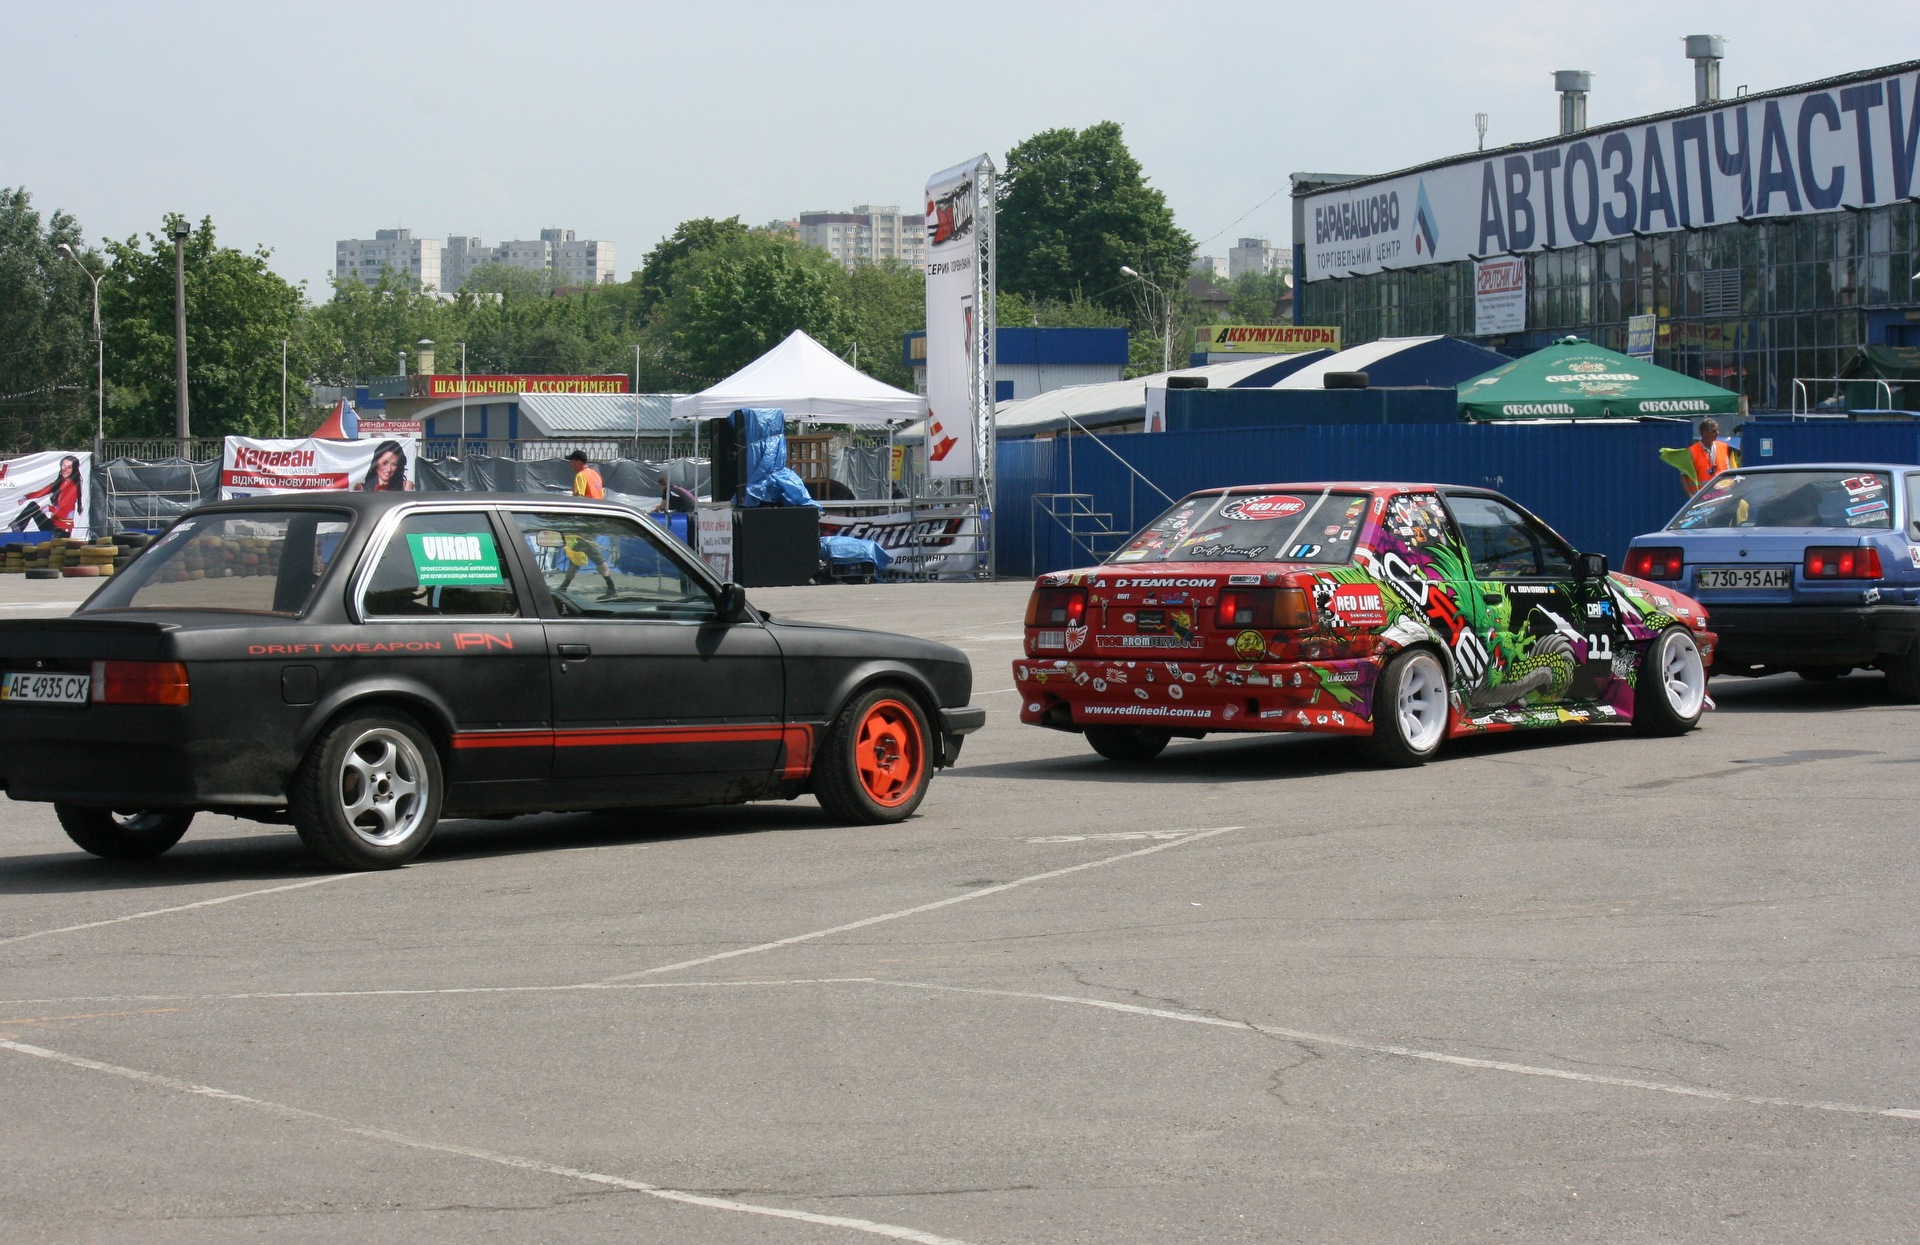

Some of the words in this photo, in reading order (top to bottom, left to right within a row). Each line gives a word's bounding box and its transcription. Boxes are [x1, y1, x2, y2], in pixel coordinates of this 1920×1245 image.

[1315, 191, 1400, 245] БАРАБАШОВО
[1316, 244, 1372, 270] ТОРГІВЕЛЬНИЙ
[1376, 239, 1401, 264] ЦЕНТР
[927, 263, 949, 275] СЕРИЯ
[1215, 328, 1334, 343] АККУМУЛЯТОРЫ
[1545, 373, 1639, 382] ОБОЛОНЬ
[434, 379, 526, 393] ШАШЛЫЧНЫЙ
[531, 380, 622, 393] АССОРТИМЕНТ
[1503, 404, 1574, 415] ОБОЛОНЬ
[1639, 401, 1710, 412] ОБОЛОНЬ
[234, 446, 315, 470] Караван
[232, 475, 276, 487] ВІДКРИТО
[278, 478, 304, 487] НОВУ
[305, 478, 334, 487] ЛІНІЮ!
[1247, 502, 1272, 511] RED
[422, 536, 482, 560] VIKAR
[1192, 544, 1220, 556] Drift
[1220, 545, 1268, 558] Yourself!
[895, 555, 949, 565] ДРИФИНГУ
[1711, 571, 1760, 586] 730-95
[1763, 571, 1785, 586] AH
[1337, 596, 1357, 611] RED
[250, 645, 322, 655] DRIFT
[331, 642, 441, 652] WEAPON
[453, 632, 514, 650] IPN
[1588, 634, 1612, 660] 11
[9, 676, 31, 698] AE
[32, 677, 63, 698] 4935
[65, 678, 87, 700] CX
[1084, 706, 1212, 717] www.redlineoil.com.ua
